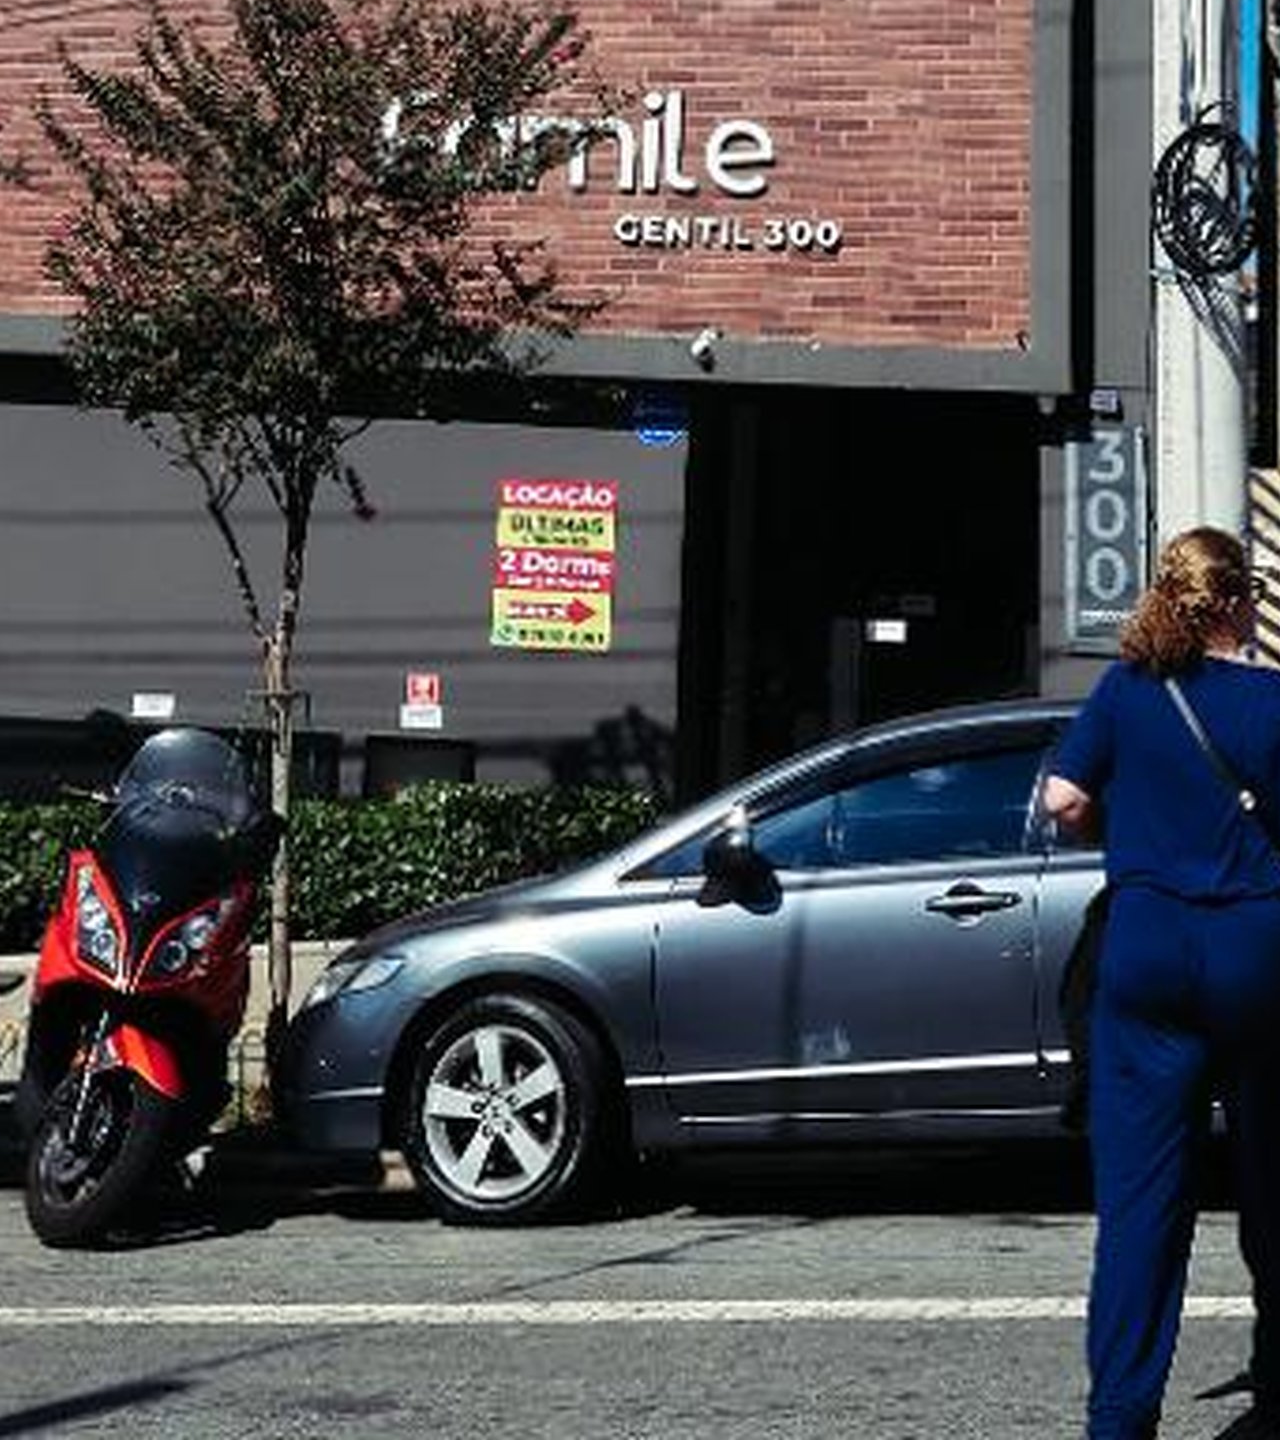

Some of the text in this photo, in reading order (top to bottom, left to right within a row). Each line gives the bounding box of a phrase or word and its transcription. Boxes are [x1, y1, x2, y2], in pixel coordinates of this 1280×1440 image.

[614, 214, 840, 248] GENTIL 300
[503, 483, 616, 506] LOCAÇÃO
[1085, 431, 1127, 600] 300
[499, 551, 516, 571] 2
